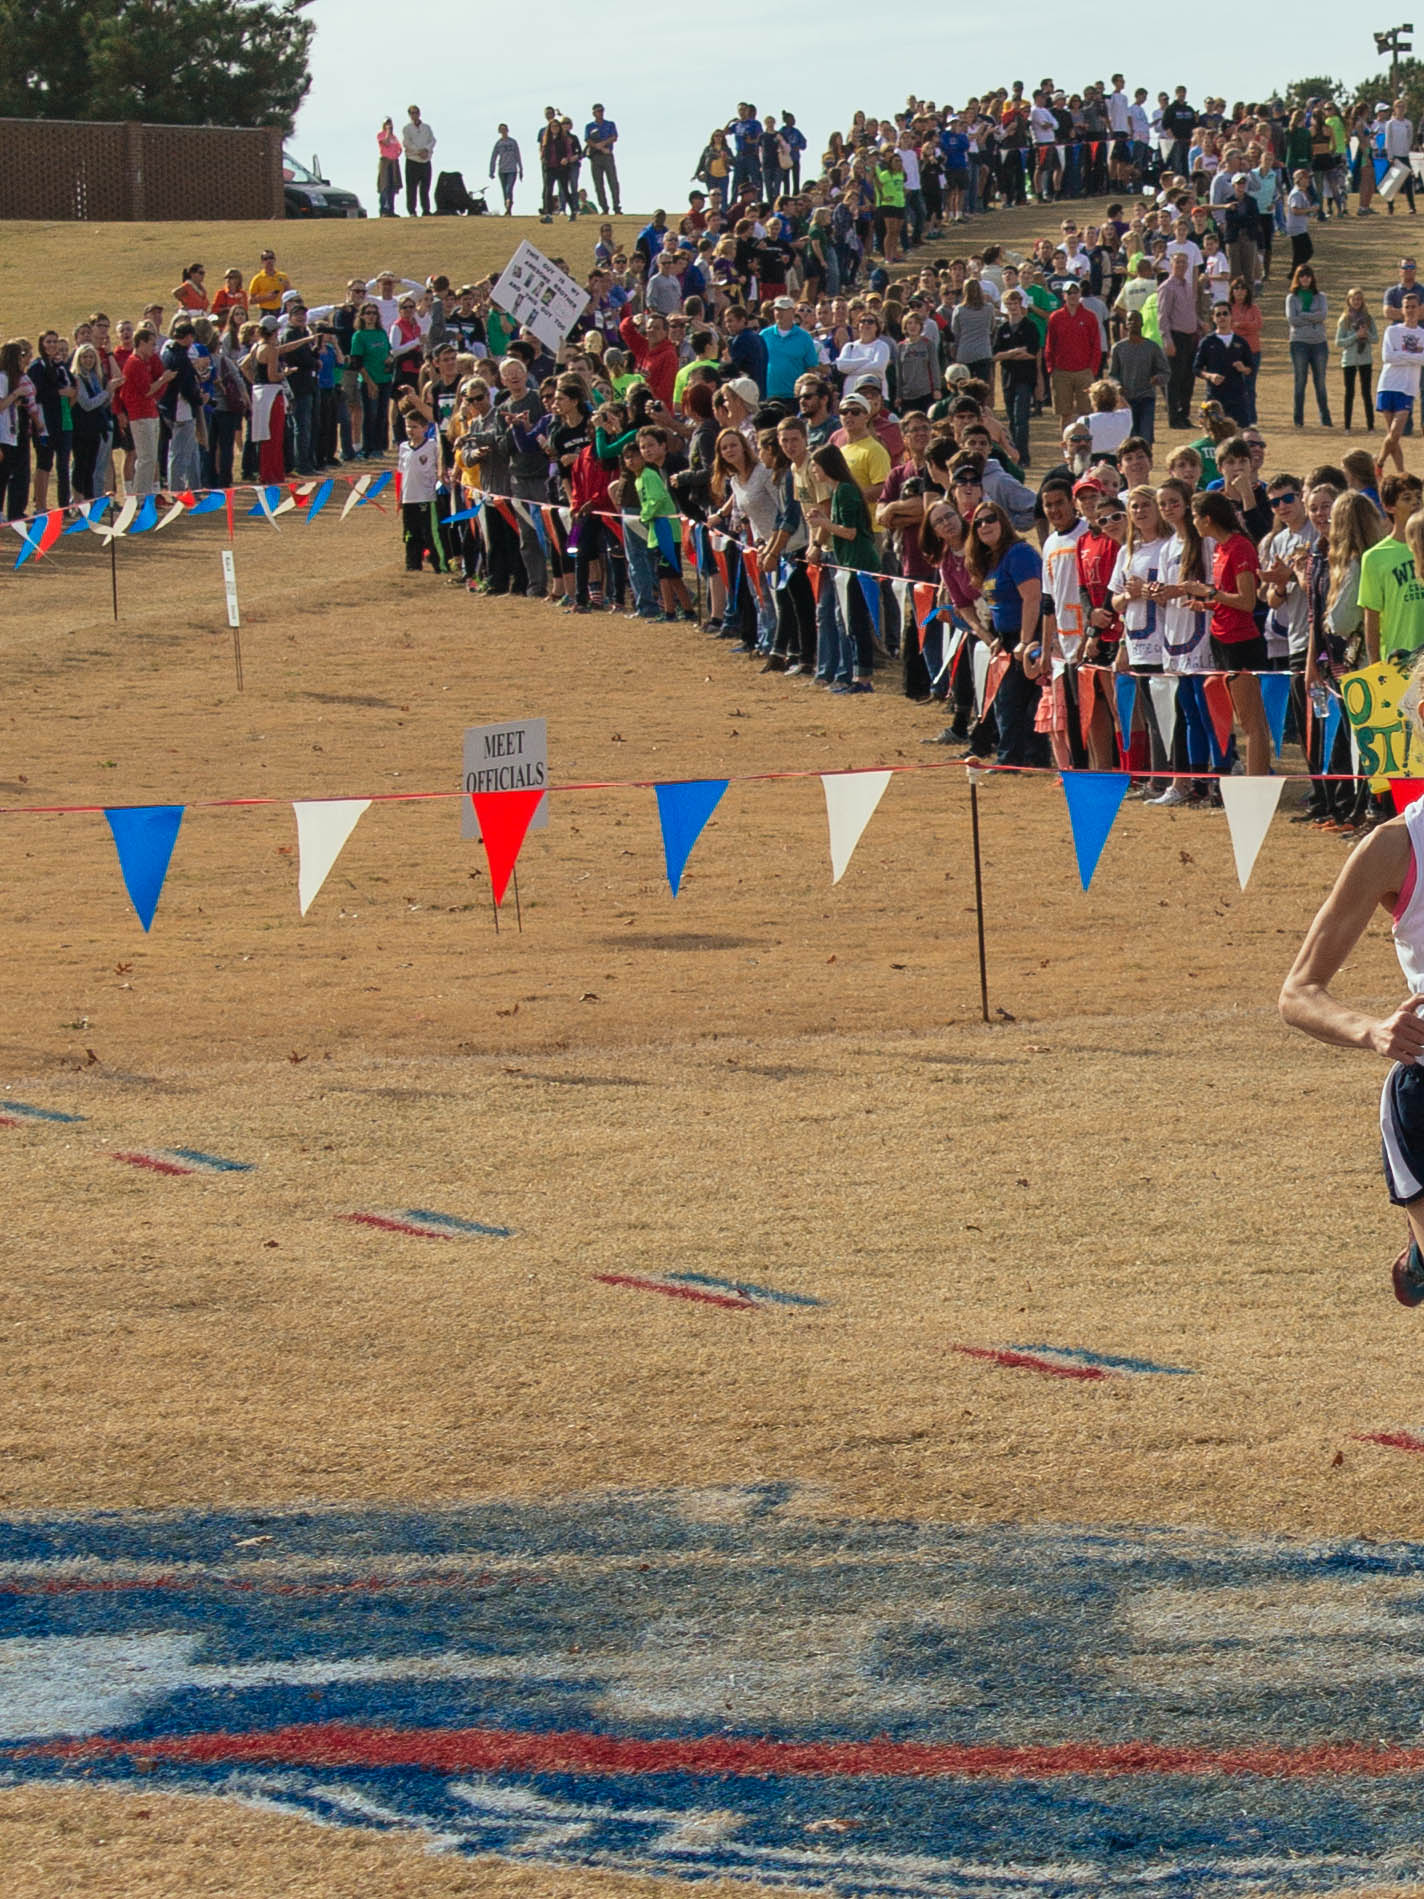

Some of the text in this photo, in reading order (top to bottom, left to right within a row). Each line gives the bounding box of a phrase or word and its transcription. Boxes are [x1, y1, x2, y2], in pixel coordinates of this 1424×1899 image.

[523, 260, 577, 308] AWESOME BROTHER
[525, 248, 580, 297] THIS GUY IS MY
[508, 280, 566, 332] AND THIS GUY TOO
[484, 730, 525, 759] MEET
[466, 761, 545, 793] OFFICIALS
